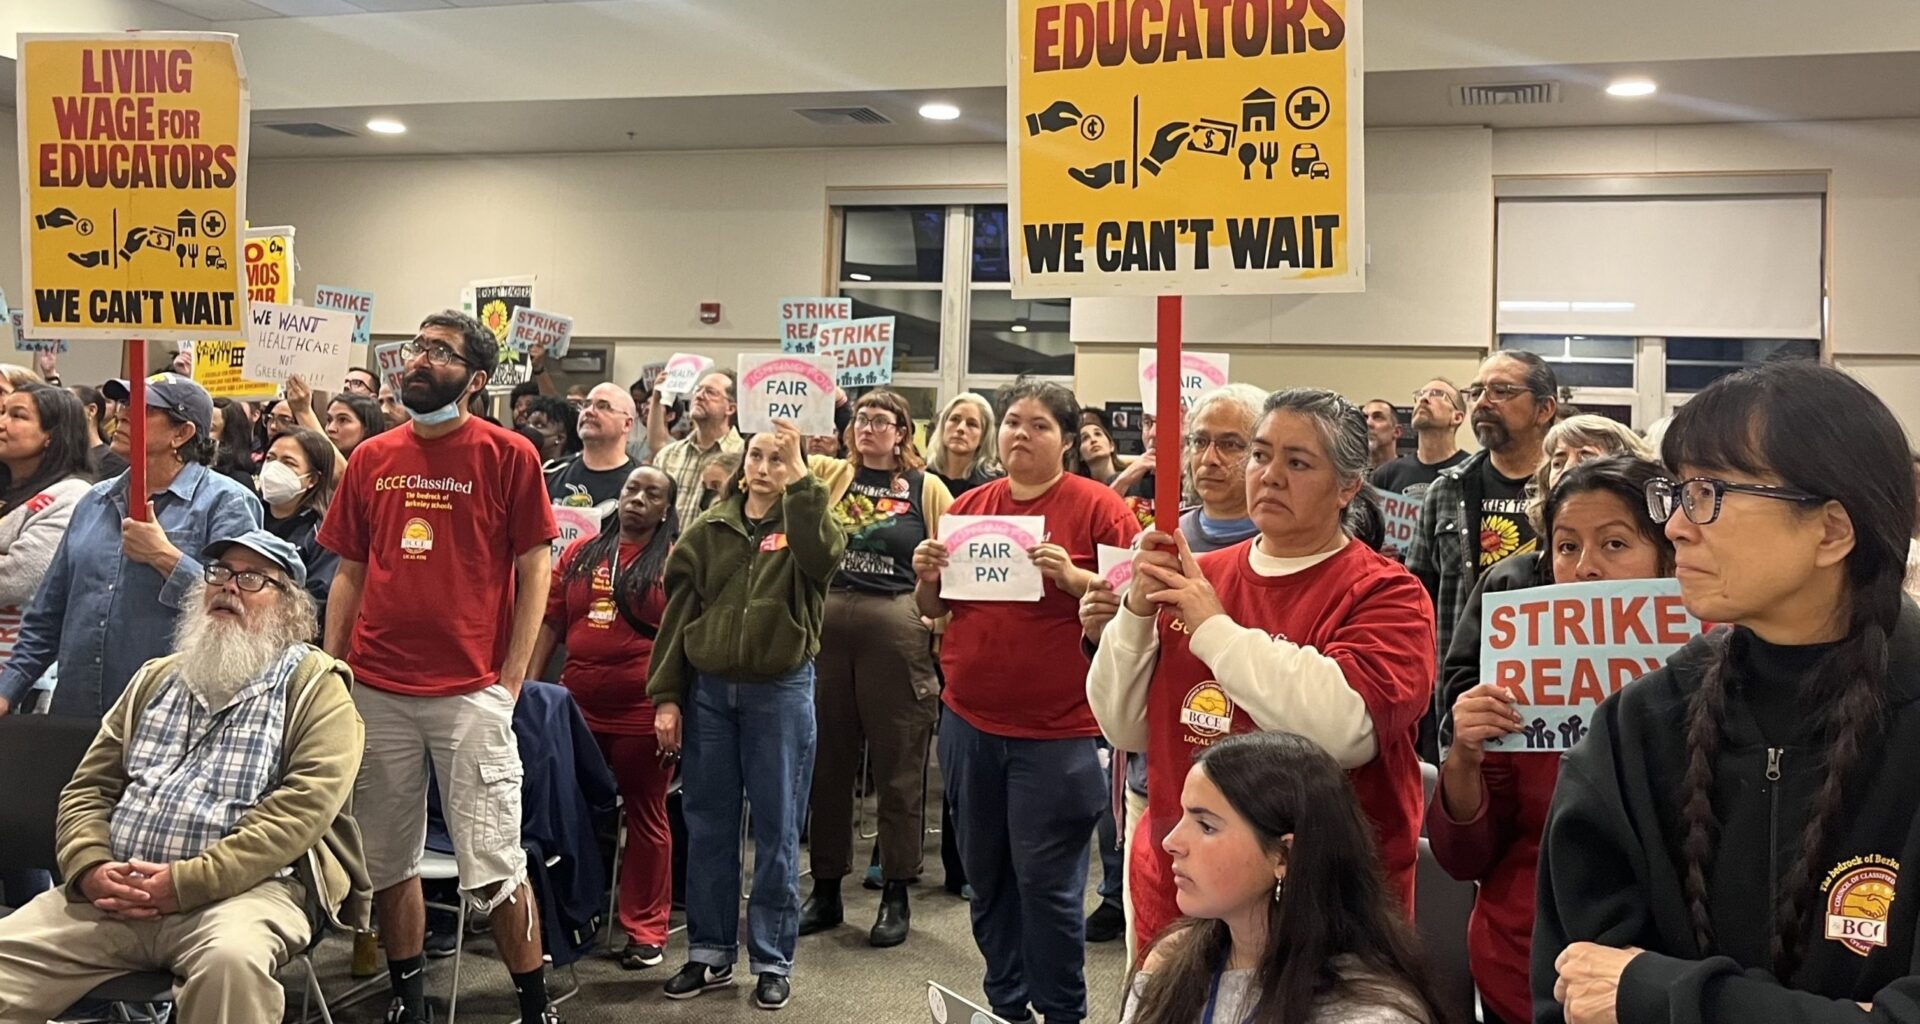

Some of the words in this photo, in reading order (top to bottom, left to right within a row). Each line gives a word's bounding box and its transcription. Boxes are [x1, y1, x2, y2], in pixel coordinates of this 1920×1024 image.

[1033, 0, 1345, 72] EDUCATORS
[82, 49, 192, 94] LIVING
[52, 96, 155, 141] WAGE
[159, 109, 200, 139] FOR
[39, 144, 236, 189] EDUCATORS
[1023, 223, 1084, 273] WE
[1096, 218, 1214, 273] CAN'T
[1226, 215, 1339, 270] WAIT
[35, 289, 80, 323] WE
[89, 290, 164, 324] CAN'T
[170, 291, 235, 325] WAIT
[317, 290, 371, 313] STRIKE
[782, 303, 848, 319] STRIKE
[253, 310, 272, 325] WE
[279, 312, 328, 333] WANT
[517, 311, 567, 336] STRIKE
[786, 323, 818, 339] REA
[259, 331, 339, 355] HEALTHCARE
[515, 326, 561, 347] READY
[819, 323, 891, 347] STRIKE
[279, 354, 296, 366] NOT
[821, 346, 886, 369] EADY
[766, 380, 808, 397] FAIR
[768, 403, 803, 418] PAY
[404, 500, 430, 510] Berkeley
[430, 502, 453, 511] schools
[416, 492, 441, 500] bedrock
[968, 543, 1011, 558] FAIR
[975, 567, 1009, 582] PAY
[1488, 595, 1691, 650] STRIKE
[1189, 711, 1222, 729] BCCE
[1184, 734, 1210, 746] LOCAL
[1820, 877, 1832, 892] The
[1828, 854, 1863, 878] bedrock
[1864, 853, 1874, 862] of
[1835, 880, 1853, 907] COUNCIL
[1851, 876, 1860, 885] OF
[1860, 872, 1895, 885] CLASSIFIED
